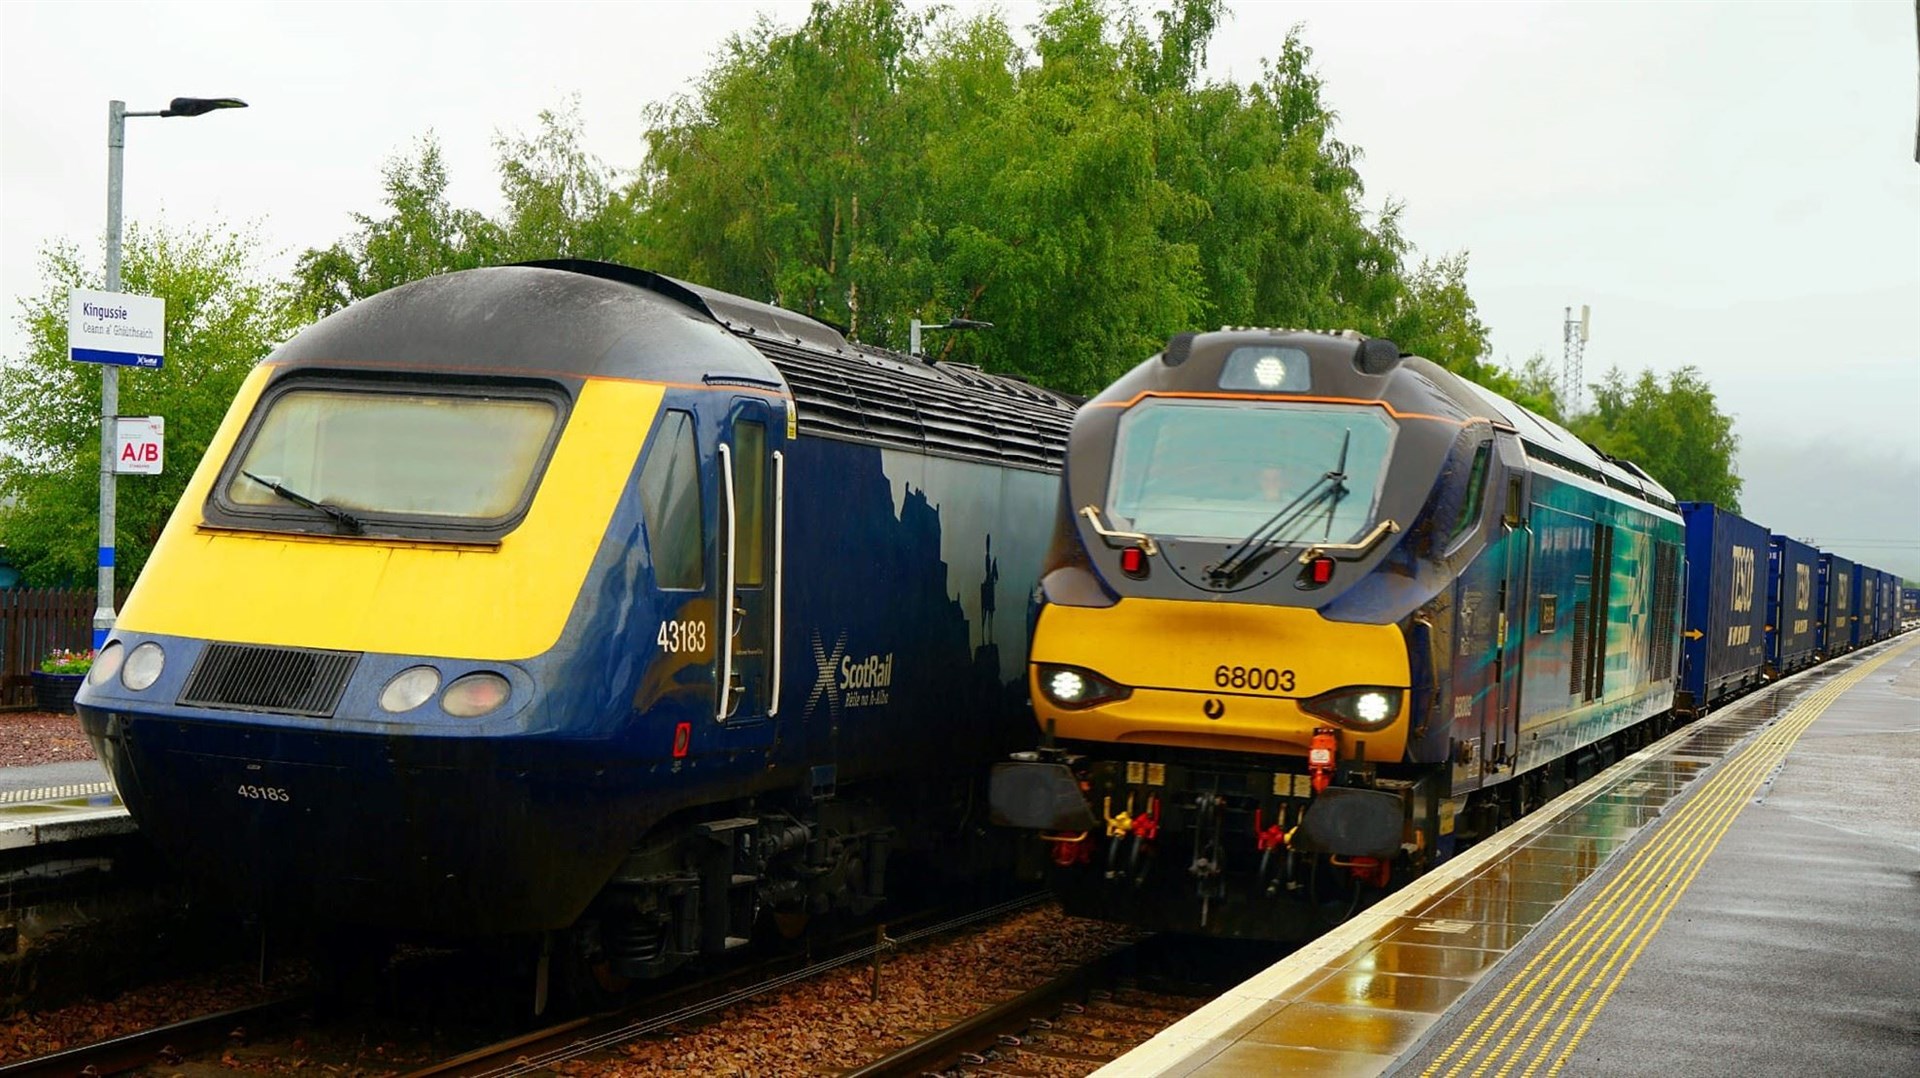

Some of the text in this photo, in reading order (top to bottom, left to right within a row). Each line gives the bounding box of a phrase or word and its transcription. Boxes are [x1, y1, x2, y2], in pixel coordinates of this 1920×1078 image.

[83, 302, 128, 321] Kingussie
[83, 322, 104, 334] Ceann
[121, 442, 159, 462] A/B
[1731, 545, 1754, 612] TESCO
[657, 620, 706, 652] 43183
[840, 652, 893, 689] ScotRail
[1215, 664, 1296, 693] 68003
[238, 784, 290, 802] 43183
